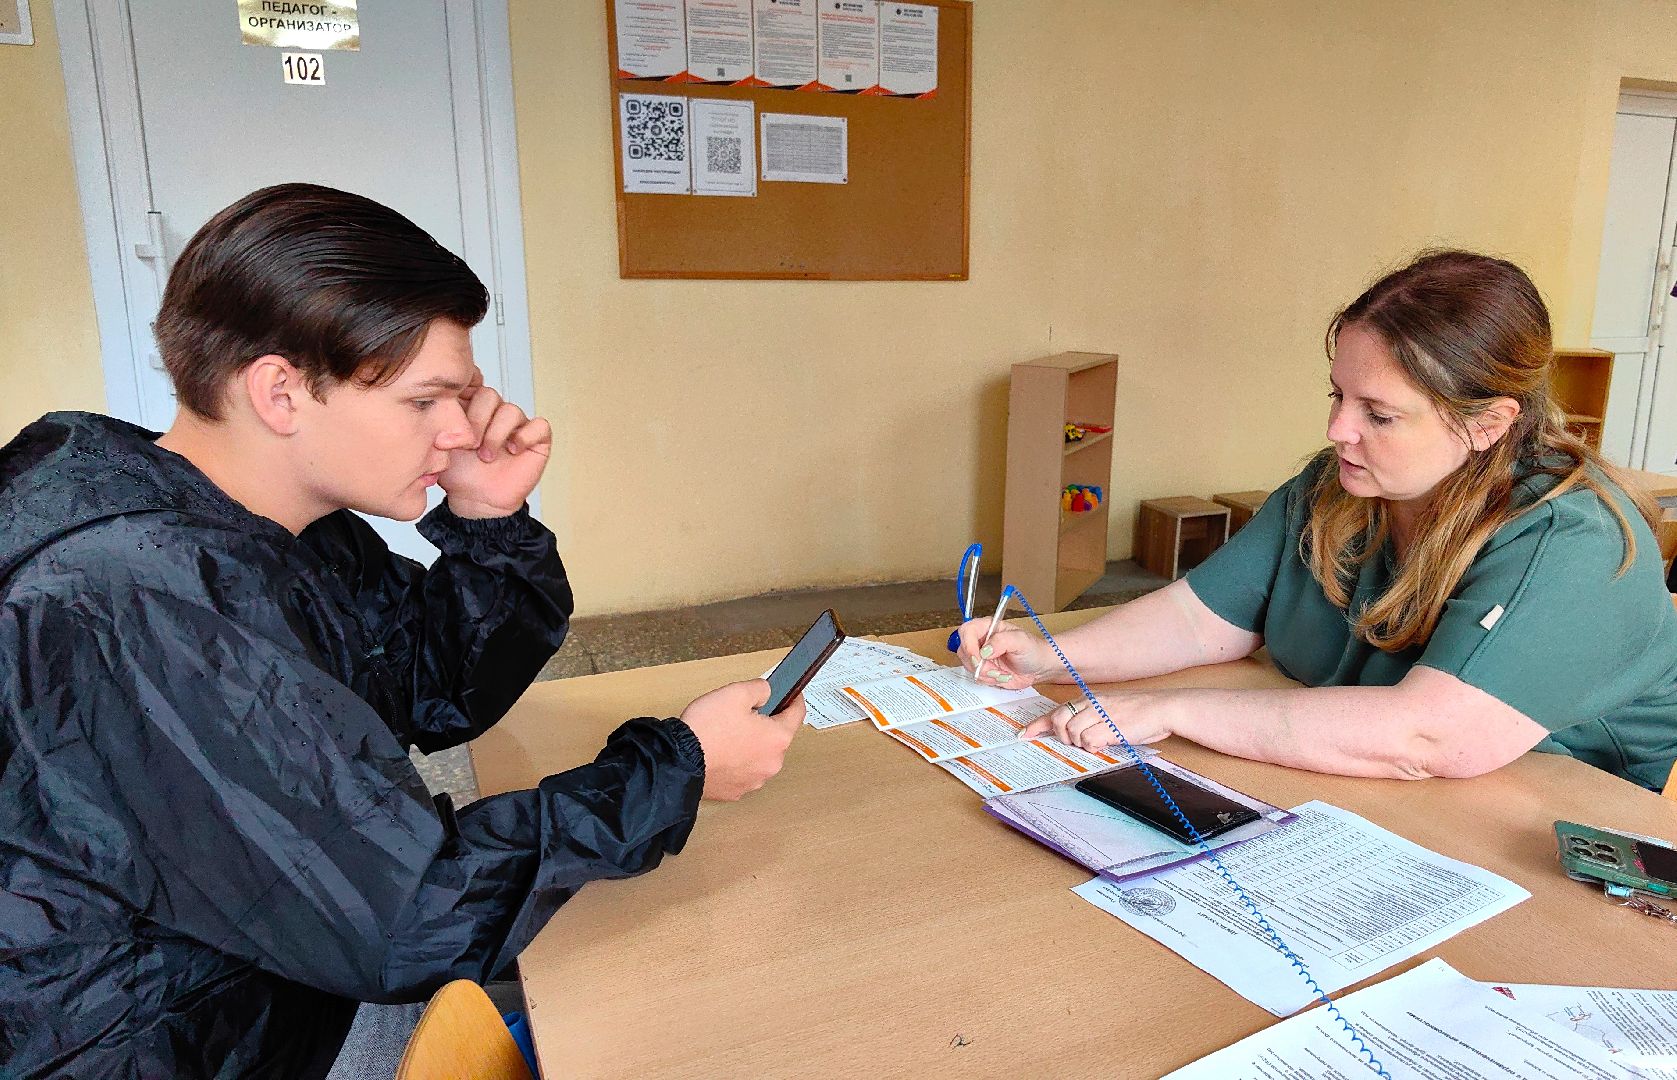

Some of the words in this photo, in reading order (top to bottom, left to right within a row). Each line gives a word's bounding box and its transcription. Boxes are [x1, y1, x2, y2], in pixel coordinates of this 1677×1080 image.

[262, 0, 328, 15] ПЕДАГОГ
[248, 16, 352, 33] ОРГАНИЗАТОР
[284, 55, 321, 80] 102
